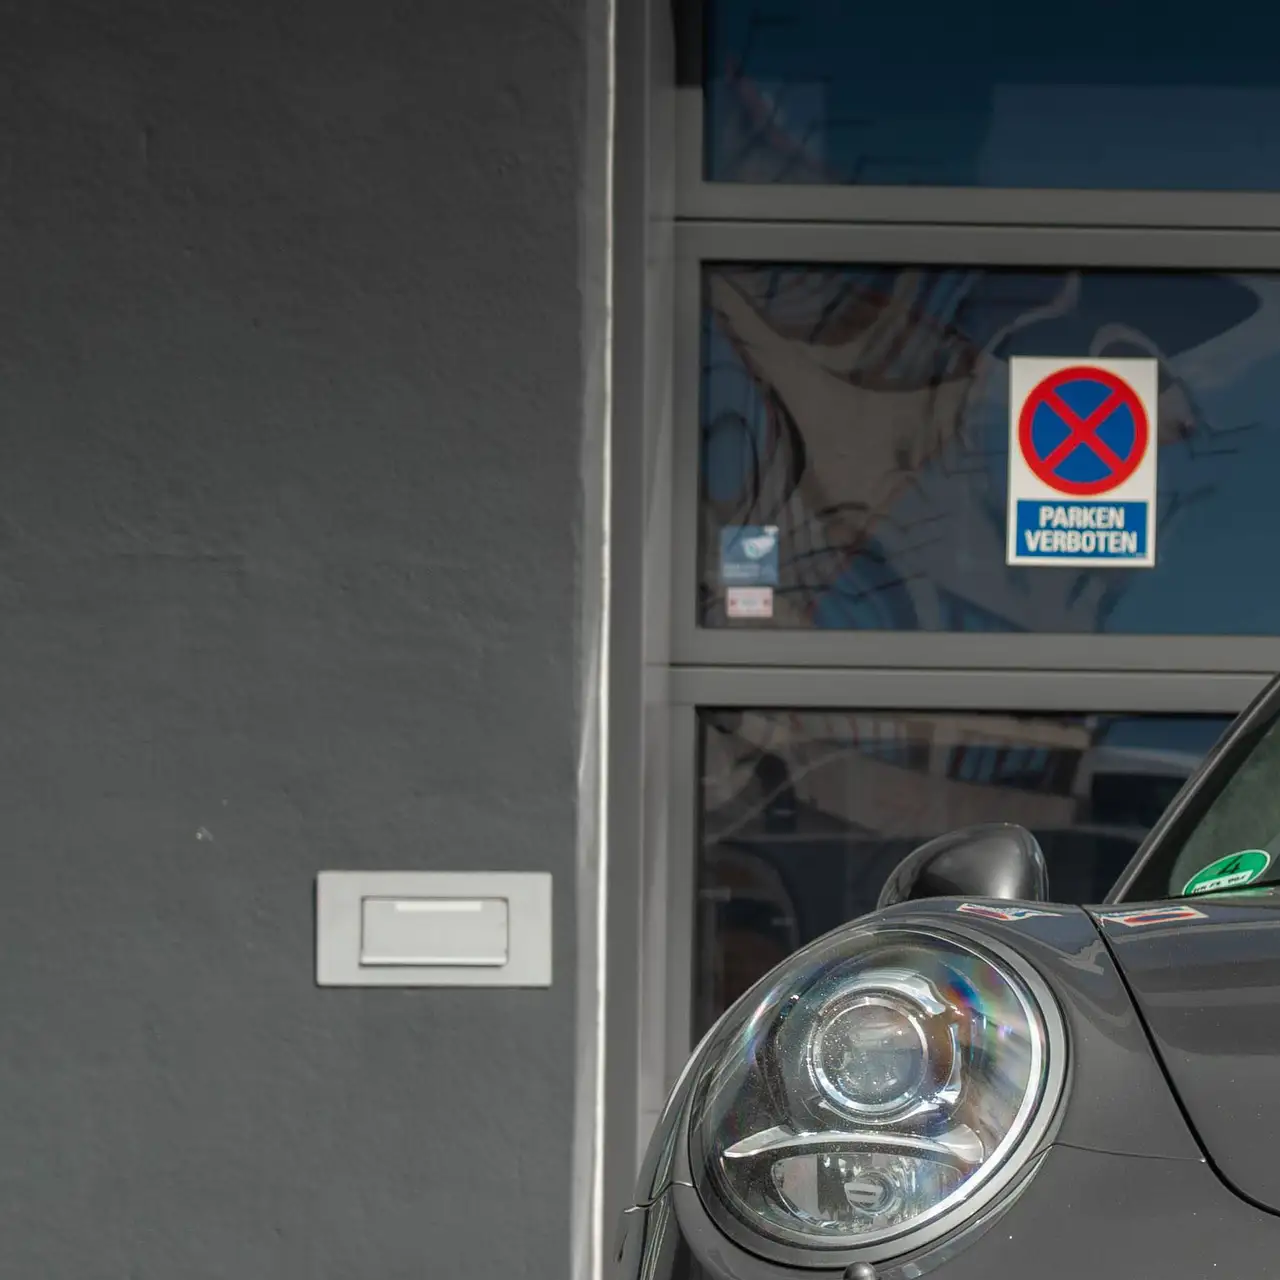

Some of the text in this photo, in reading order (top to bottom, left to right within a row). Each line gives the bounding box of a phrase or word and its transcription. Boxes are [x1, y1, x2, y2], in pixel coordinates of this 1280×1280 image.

[1038, 505, 1126, 529] PARKEN
[1024, 529, 1138, 554] VERBOTEN
[1217, 855, 1243, 875] 4
